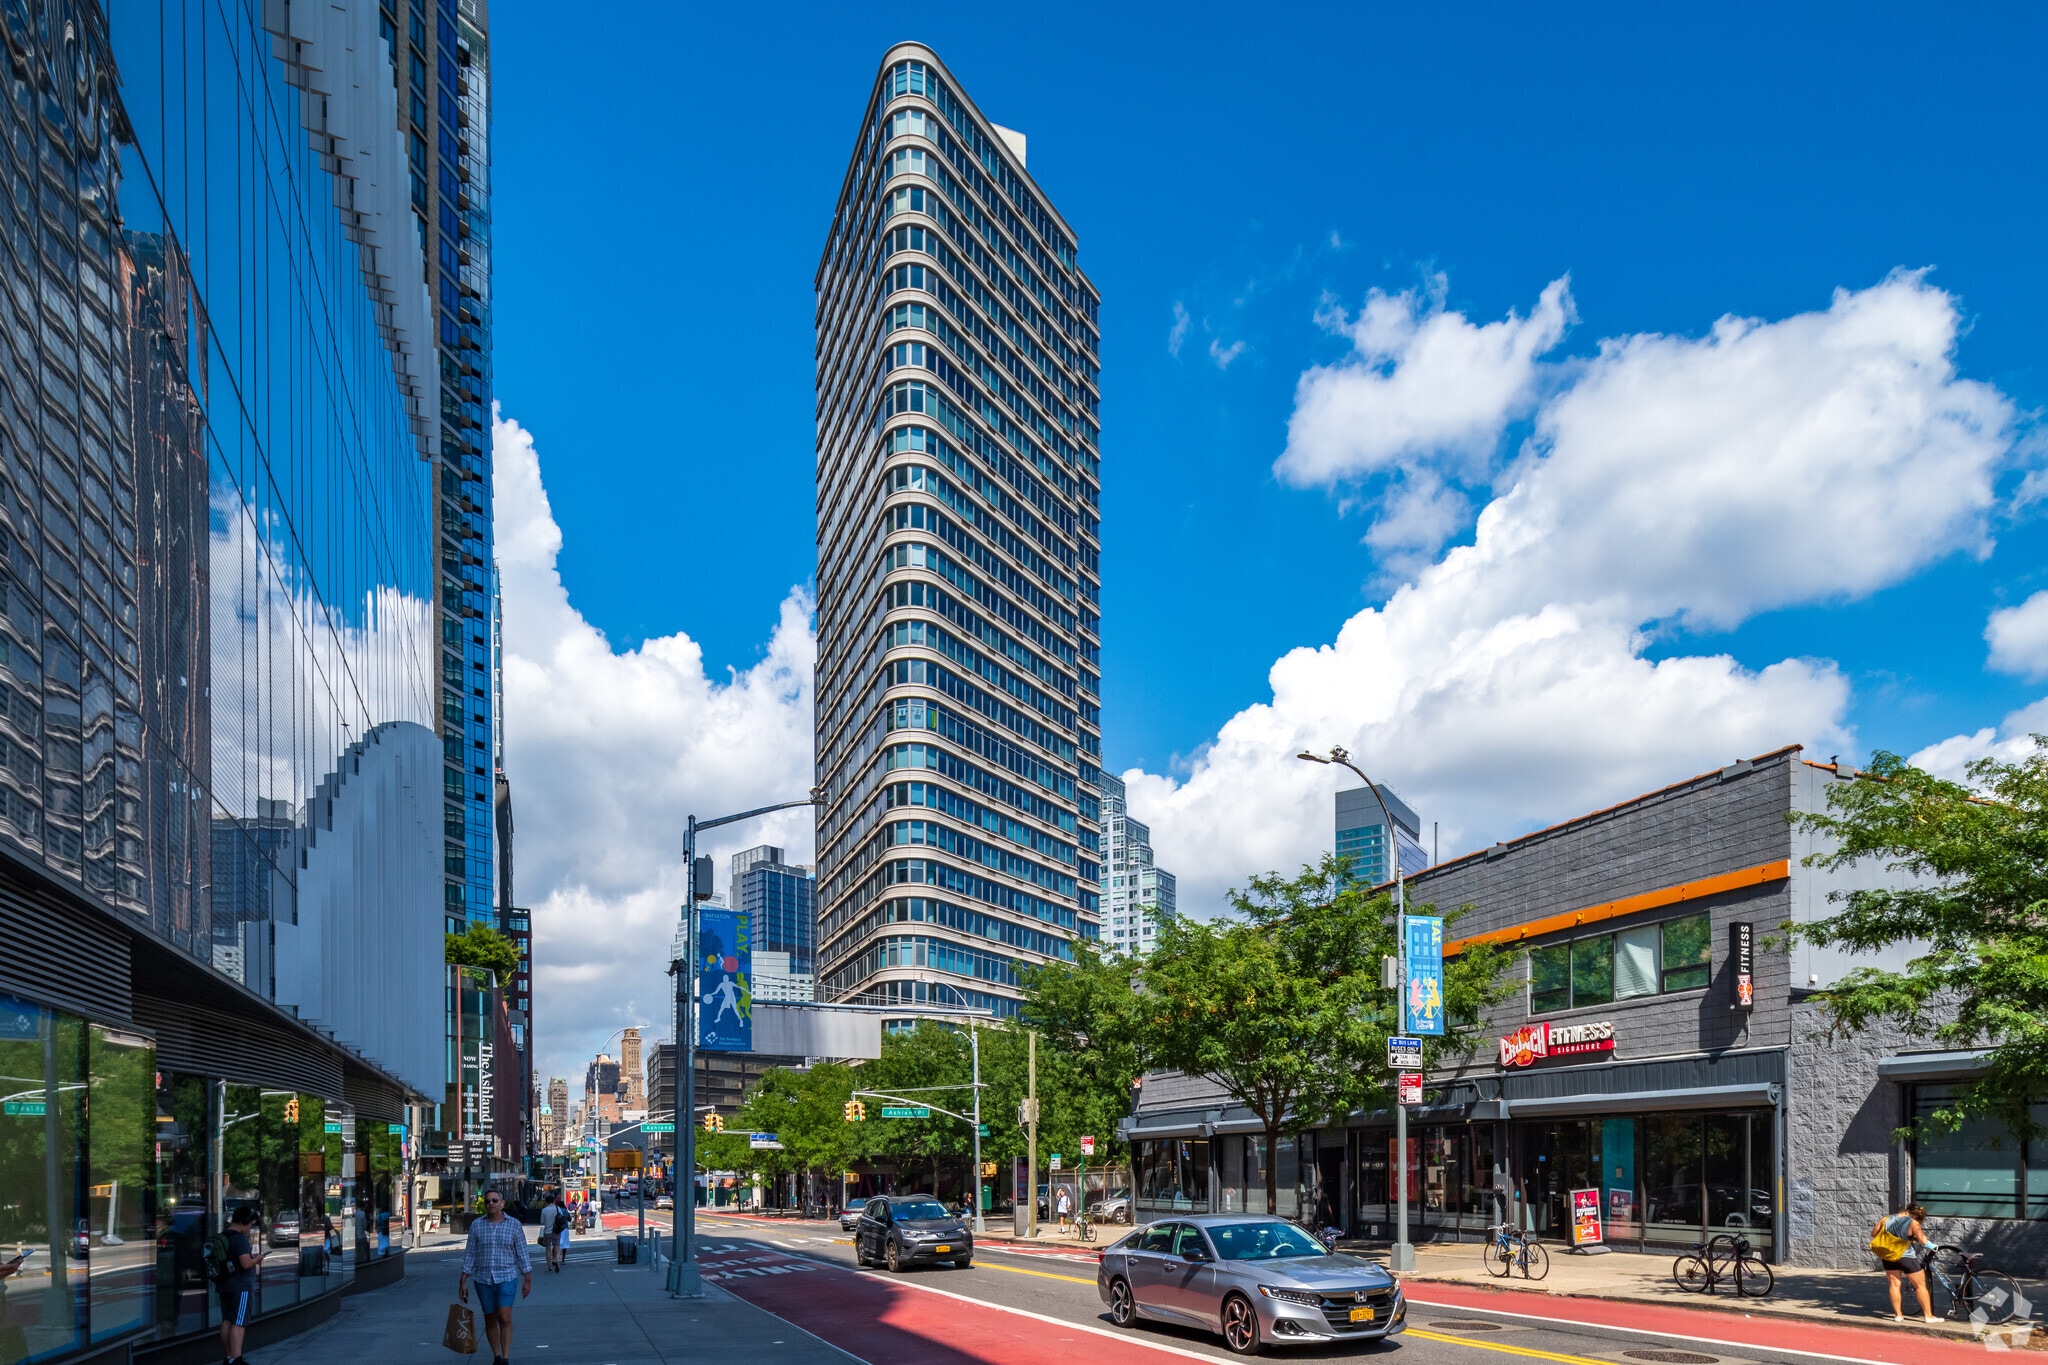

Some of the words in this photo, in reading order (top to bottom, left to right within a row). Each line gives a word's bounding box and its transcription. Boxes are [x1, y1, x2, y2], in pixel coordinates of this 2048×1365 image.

[736, 915, 748, 957] PLAY.
[1431, 920, 1441, 947] EAT.
[1740, 925, 1750, 973] FITNESS
[1501, 1023, 1546, 1065] CRUNCH
[1548, 1021, 1612, 1046] FITNESS
[1557, 1043, 1600, 1054] SIGNATURE
[481, 1070, 494, 1122] Ashland
